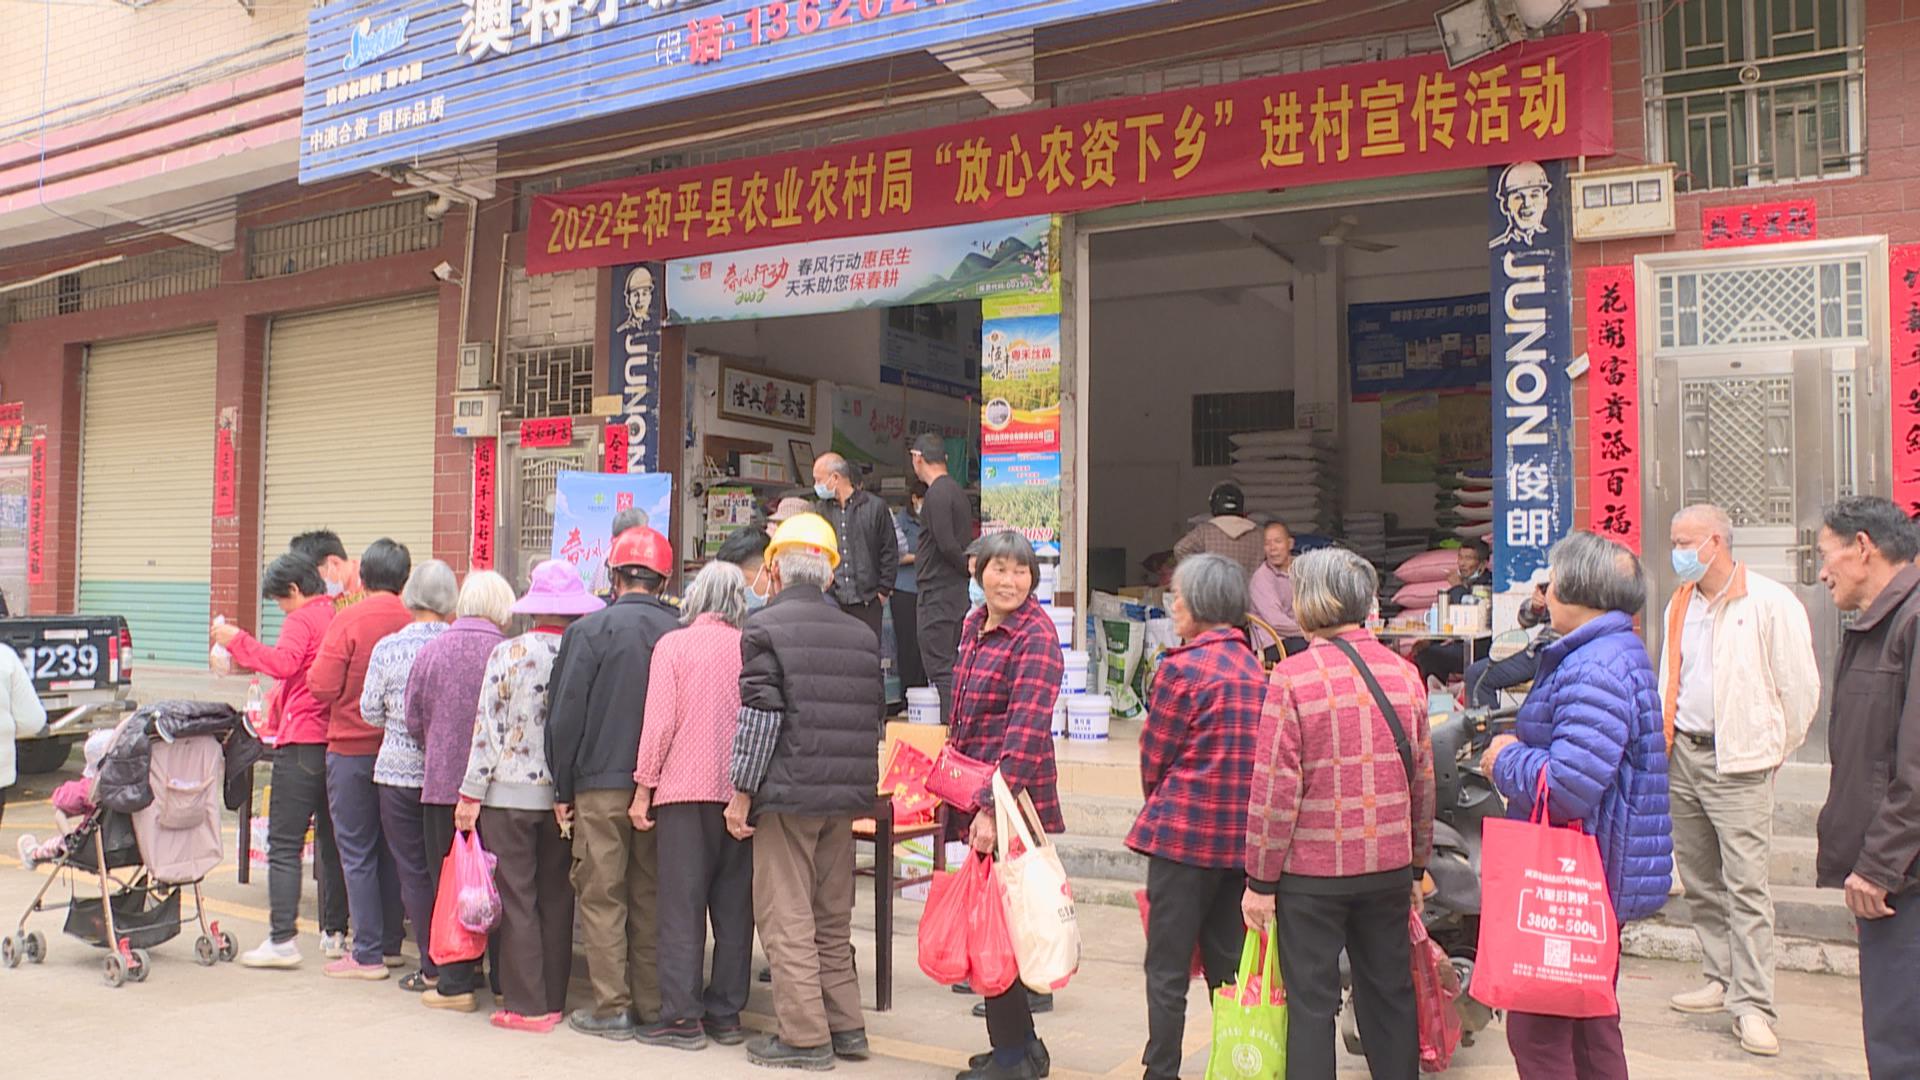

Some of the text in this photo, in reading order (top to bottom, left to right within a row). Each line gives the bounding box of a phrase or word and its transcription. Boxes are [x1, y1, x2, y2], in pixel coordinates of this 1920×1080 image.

[310, 95, 445, 152] 中澳合资 国际品质
[547, 149, 913, 254] 2022年和平县农业农村局
[1260, 56, 1567, 168] 进村宣传活动
[785, 269, 900, 298] 天禾助您保春耕
[798, 246, 912, 276] 春风行动惠民生
[624, 334, 648, 474] JUNON
[1504, 251, 1550, 546] JUNON 俊朗
